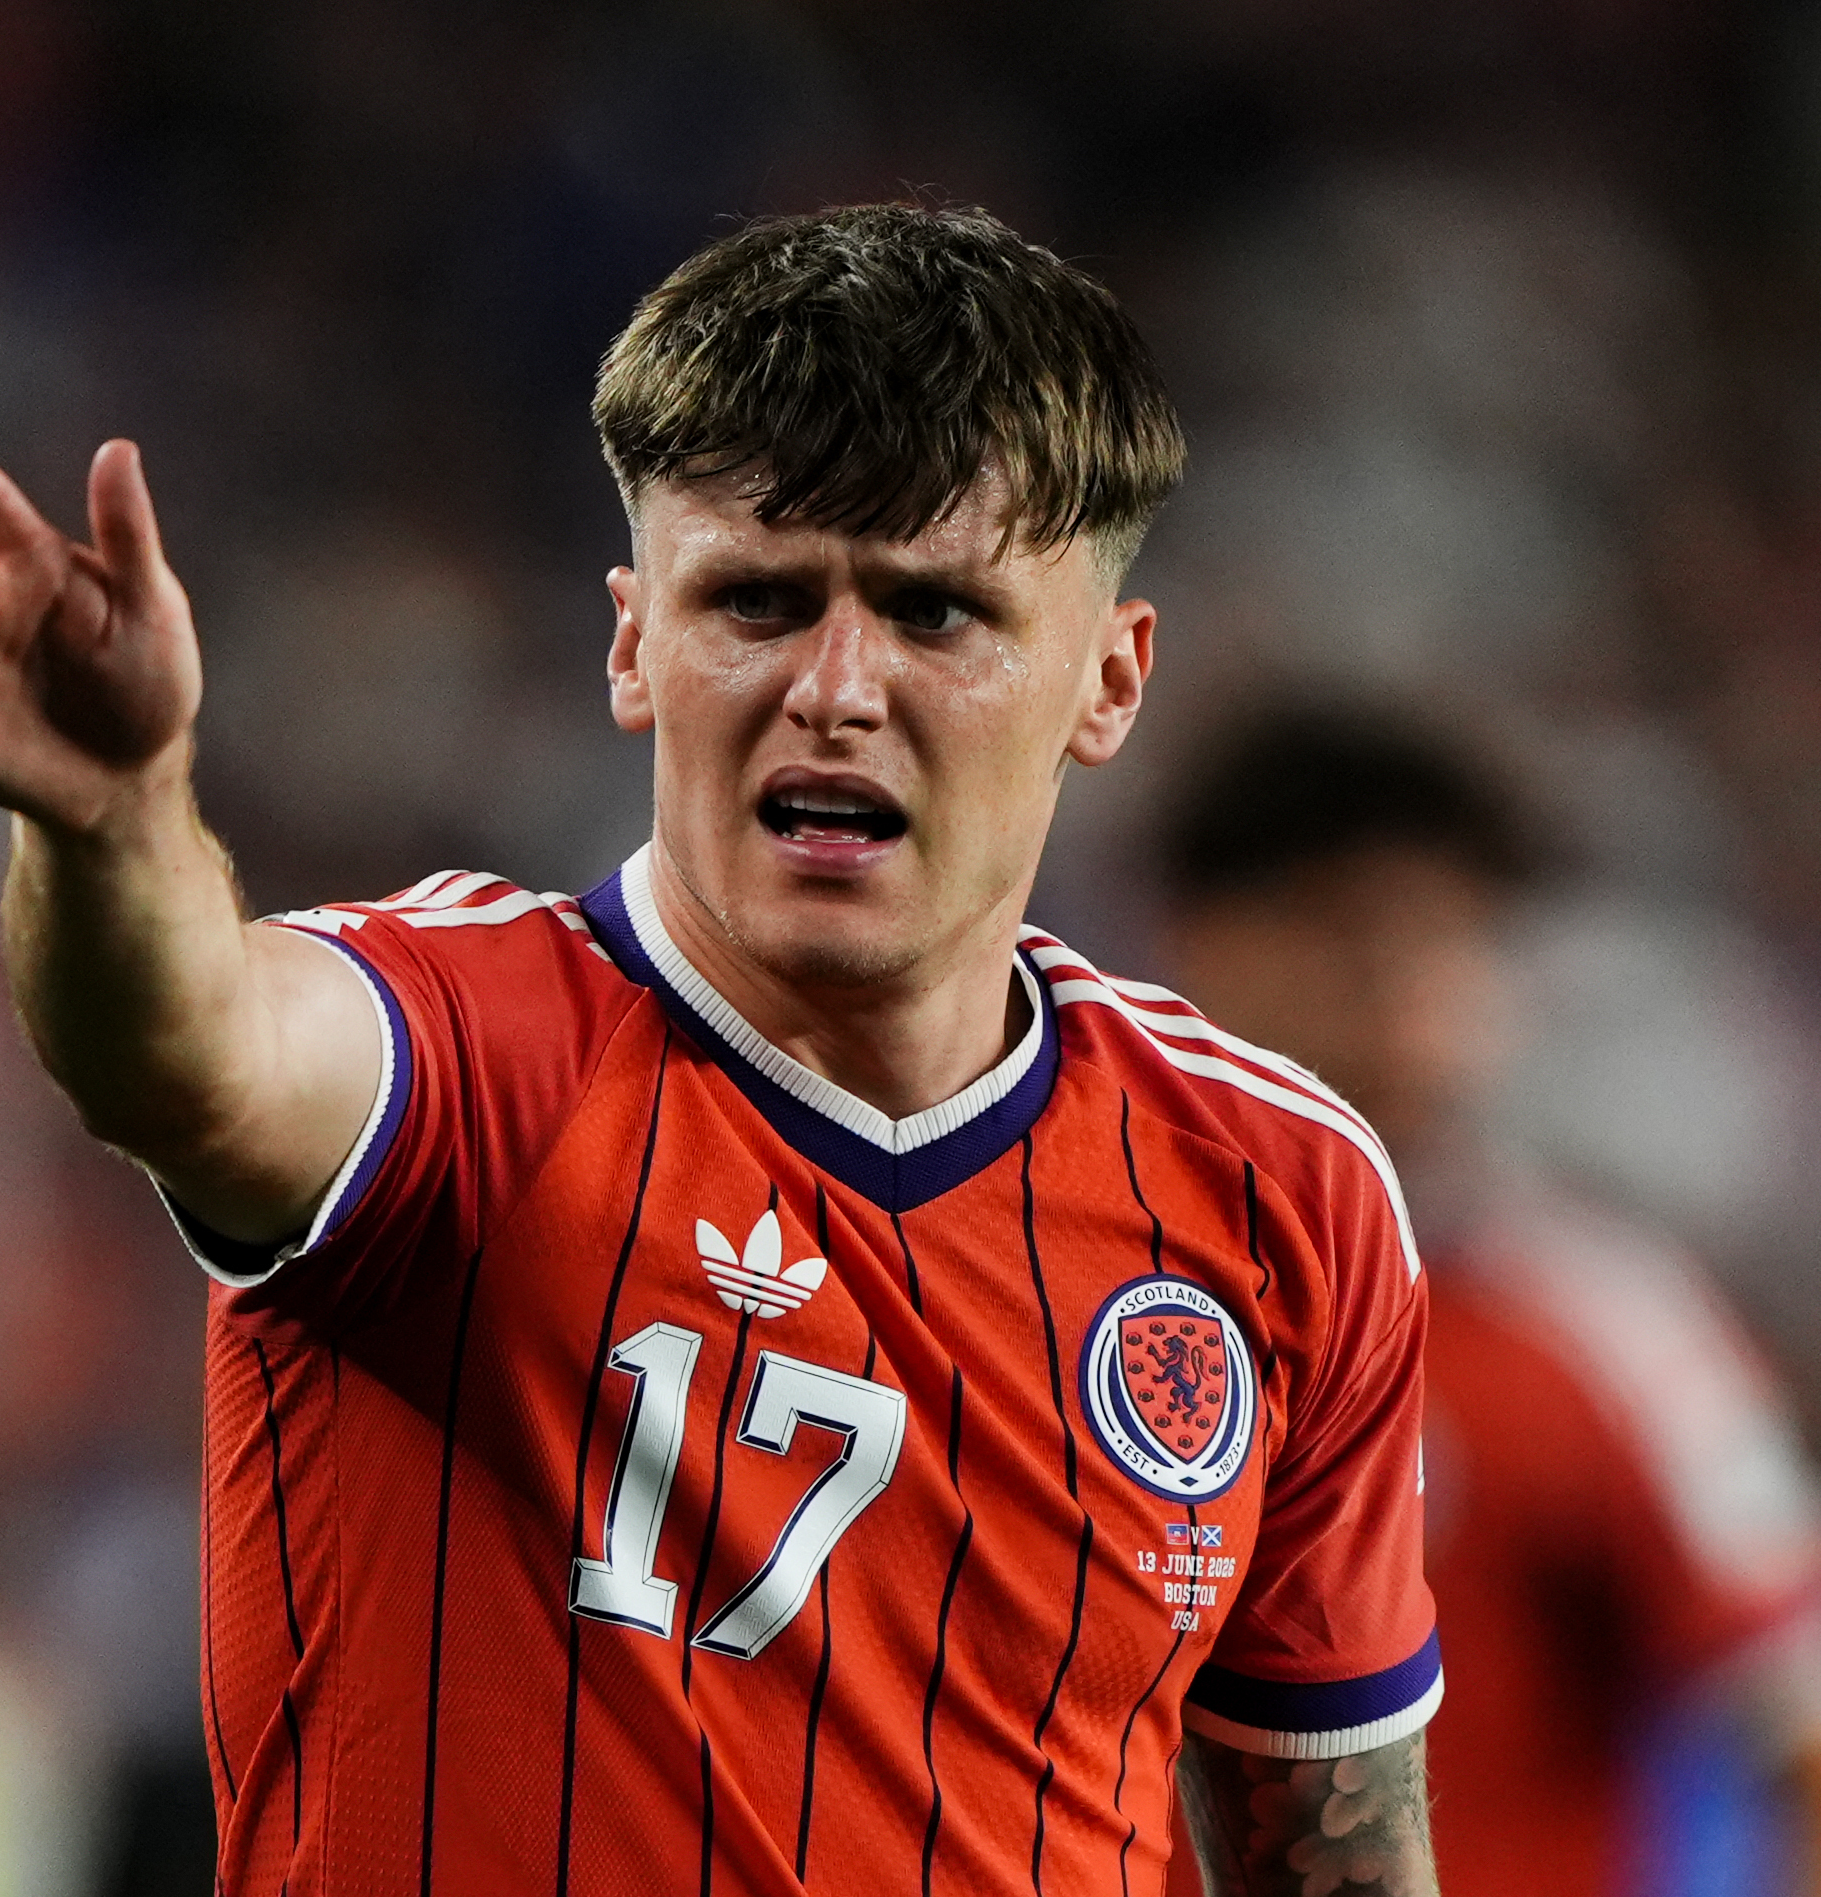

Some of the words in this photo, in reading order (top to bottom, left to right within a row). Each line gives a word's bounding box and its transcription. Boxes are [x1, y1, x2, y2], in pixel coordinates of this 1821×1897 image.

[1125, 1286, 1209, 1311] SCOTLAND
[1122, 1444, 1150, 1470] EST
[1219, 1447, 1240, 1475] 1873
[568, 1320, 907, 1661] 17
[1190, 1526, 1200, 1545] V
[1137, 1550, 1157, 1573] 13
[1161, 1553, 1205, 1577] JUNE
[1207, 1556, 1237, 1578] 2026
[1164, 1581, 1218, 1606] BOSTON
[1170, 1610, 1200, 1632] USA
